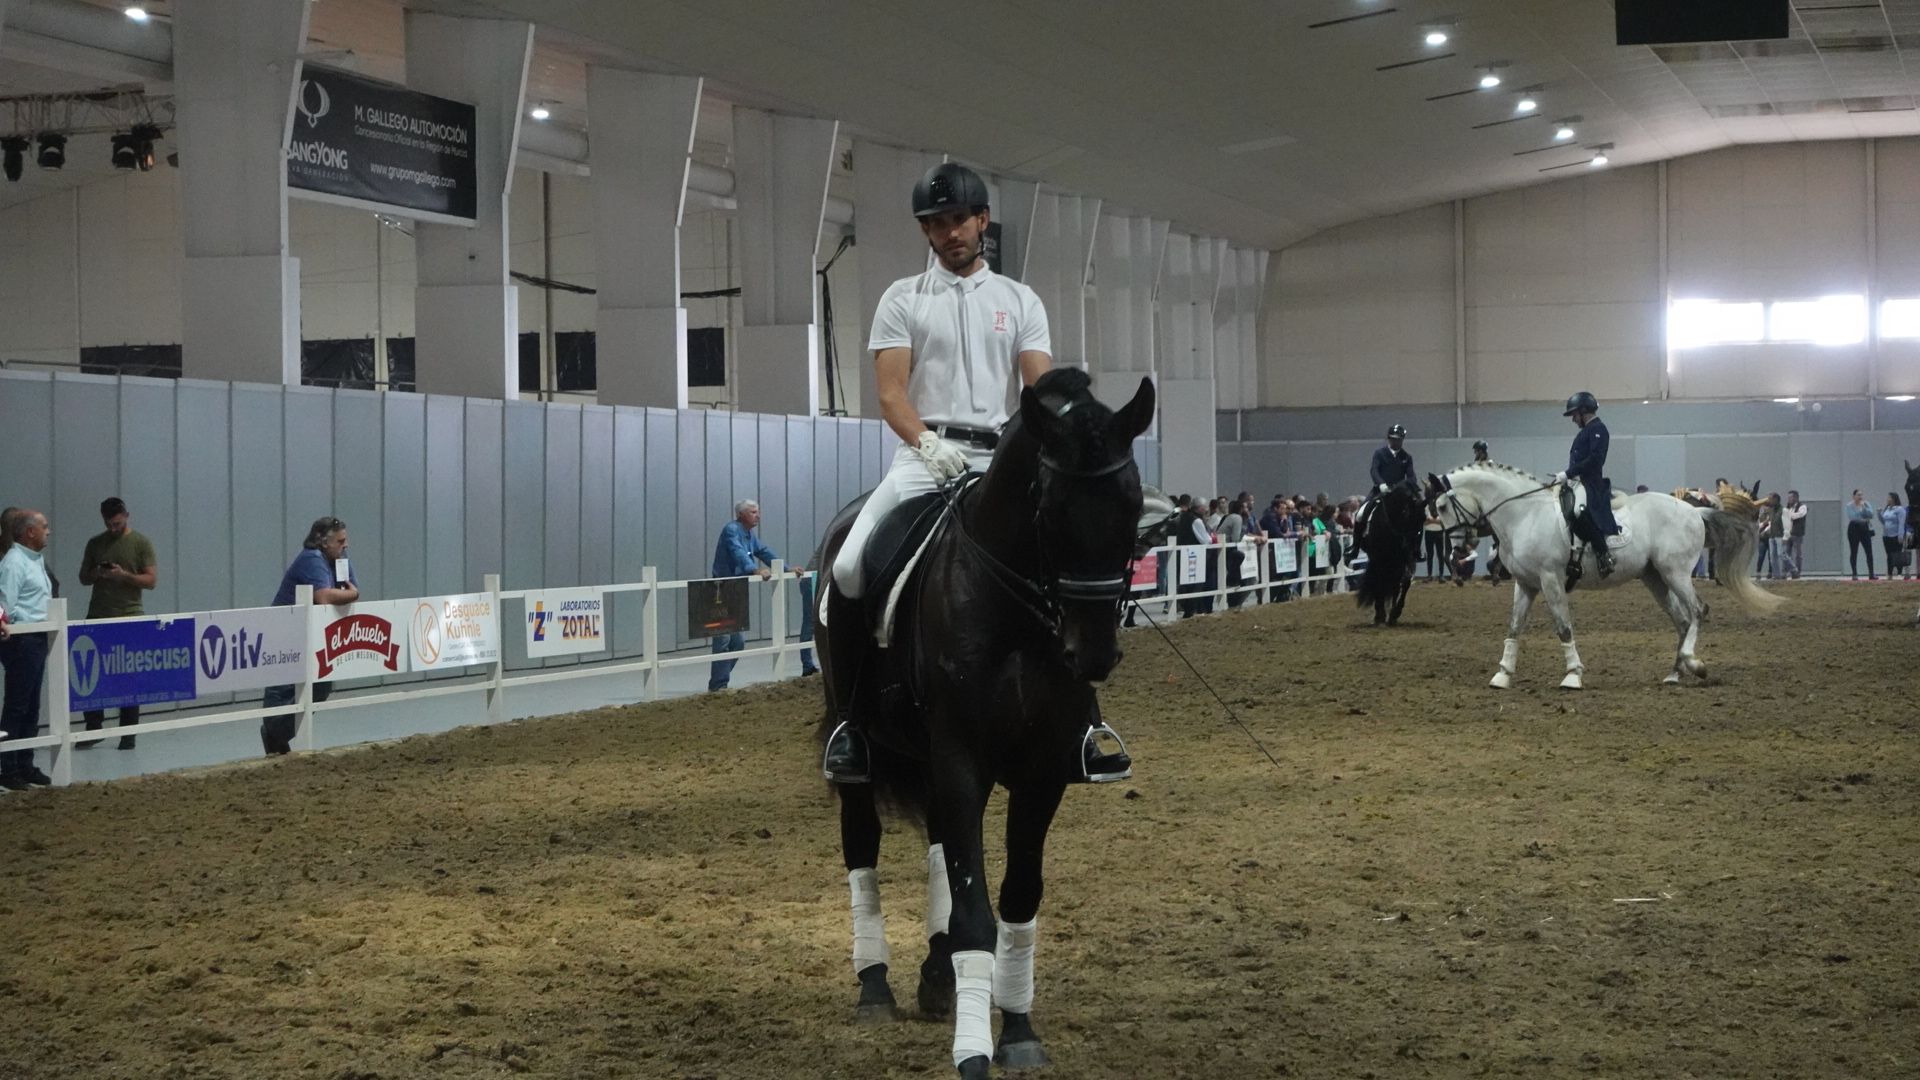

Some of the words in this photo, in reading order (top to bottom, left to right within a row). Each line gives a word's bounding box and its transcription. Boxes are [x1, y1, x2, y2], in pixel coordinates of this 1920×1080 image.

[354, 106, 365, 122] M.
[367, 107, 408, 132] GALLEGO
[410, 118, 468, 144] AUTOMOCIÓN
[370, 162, 457, 189] www.grupomgallego.com
[444, 600, 490, 621] Desguace
[560, 600, 600, 612] LABORATORIOS
[232, 626, 263, 670] itv
[262, 651, 276, 665] San
[278, 650, 301, 666] Javier
[331, 625, 342, 651] el
[343, 620, 388, 646] Abuelo
[102, 644, 190, 675] villaescusa
